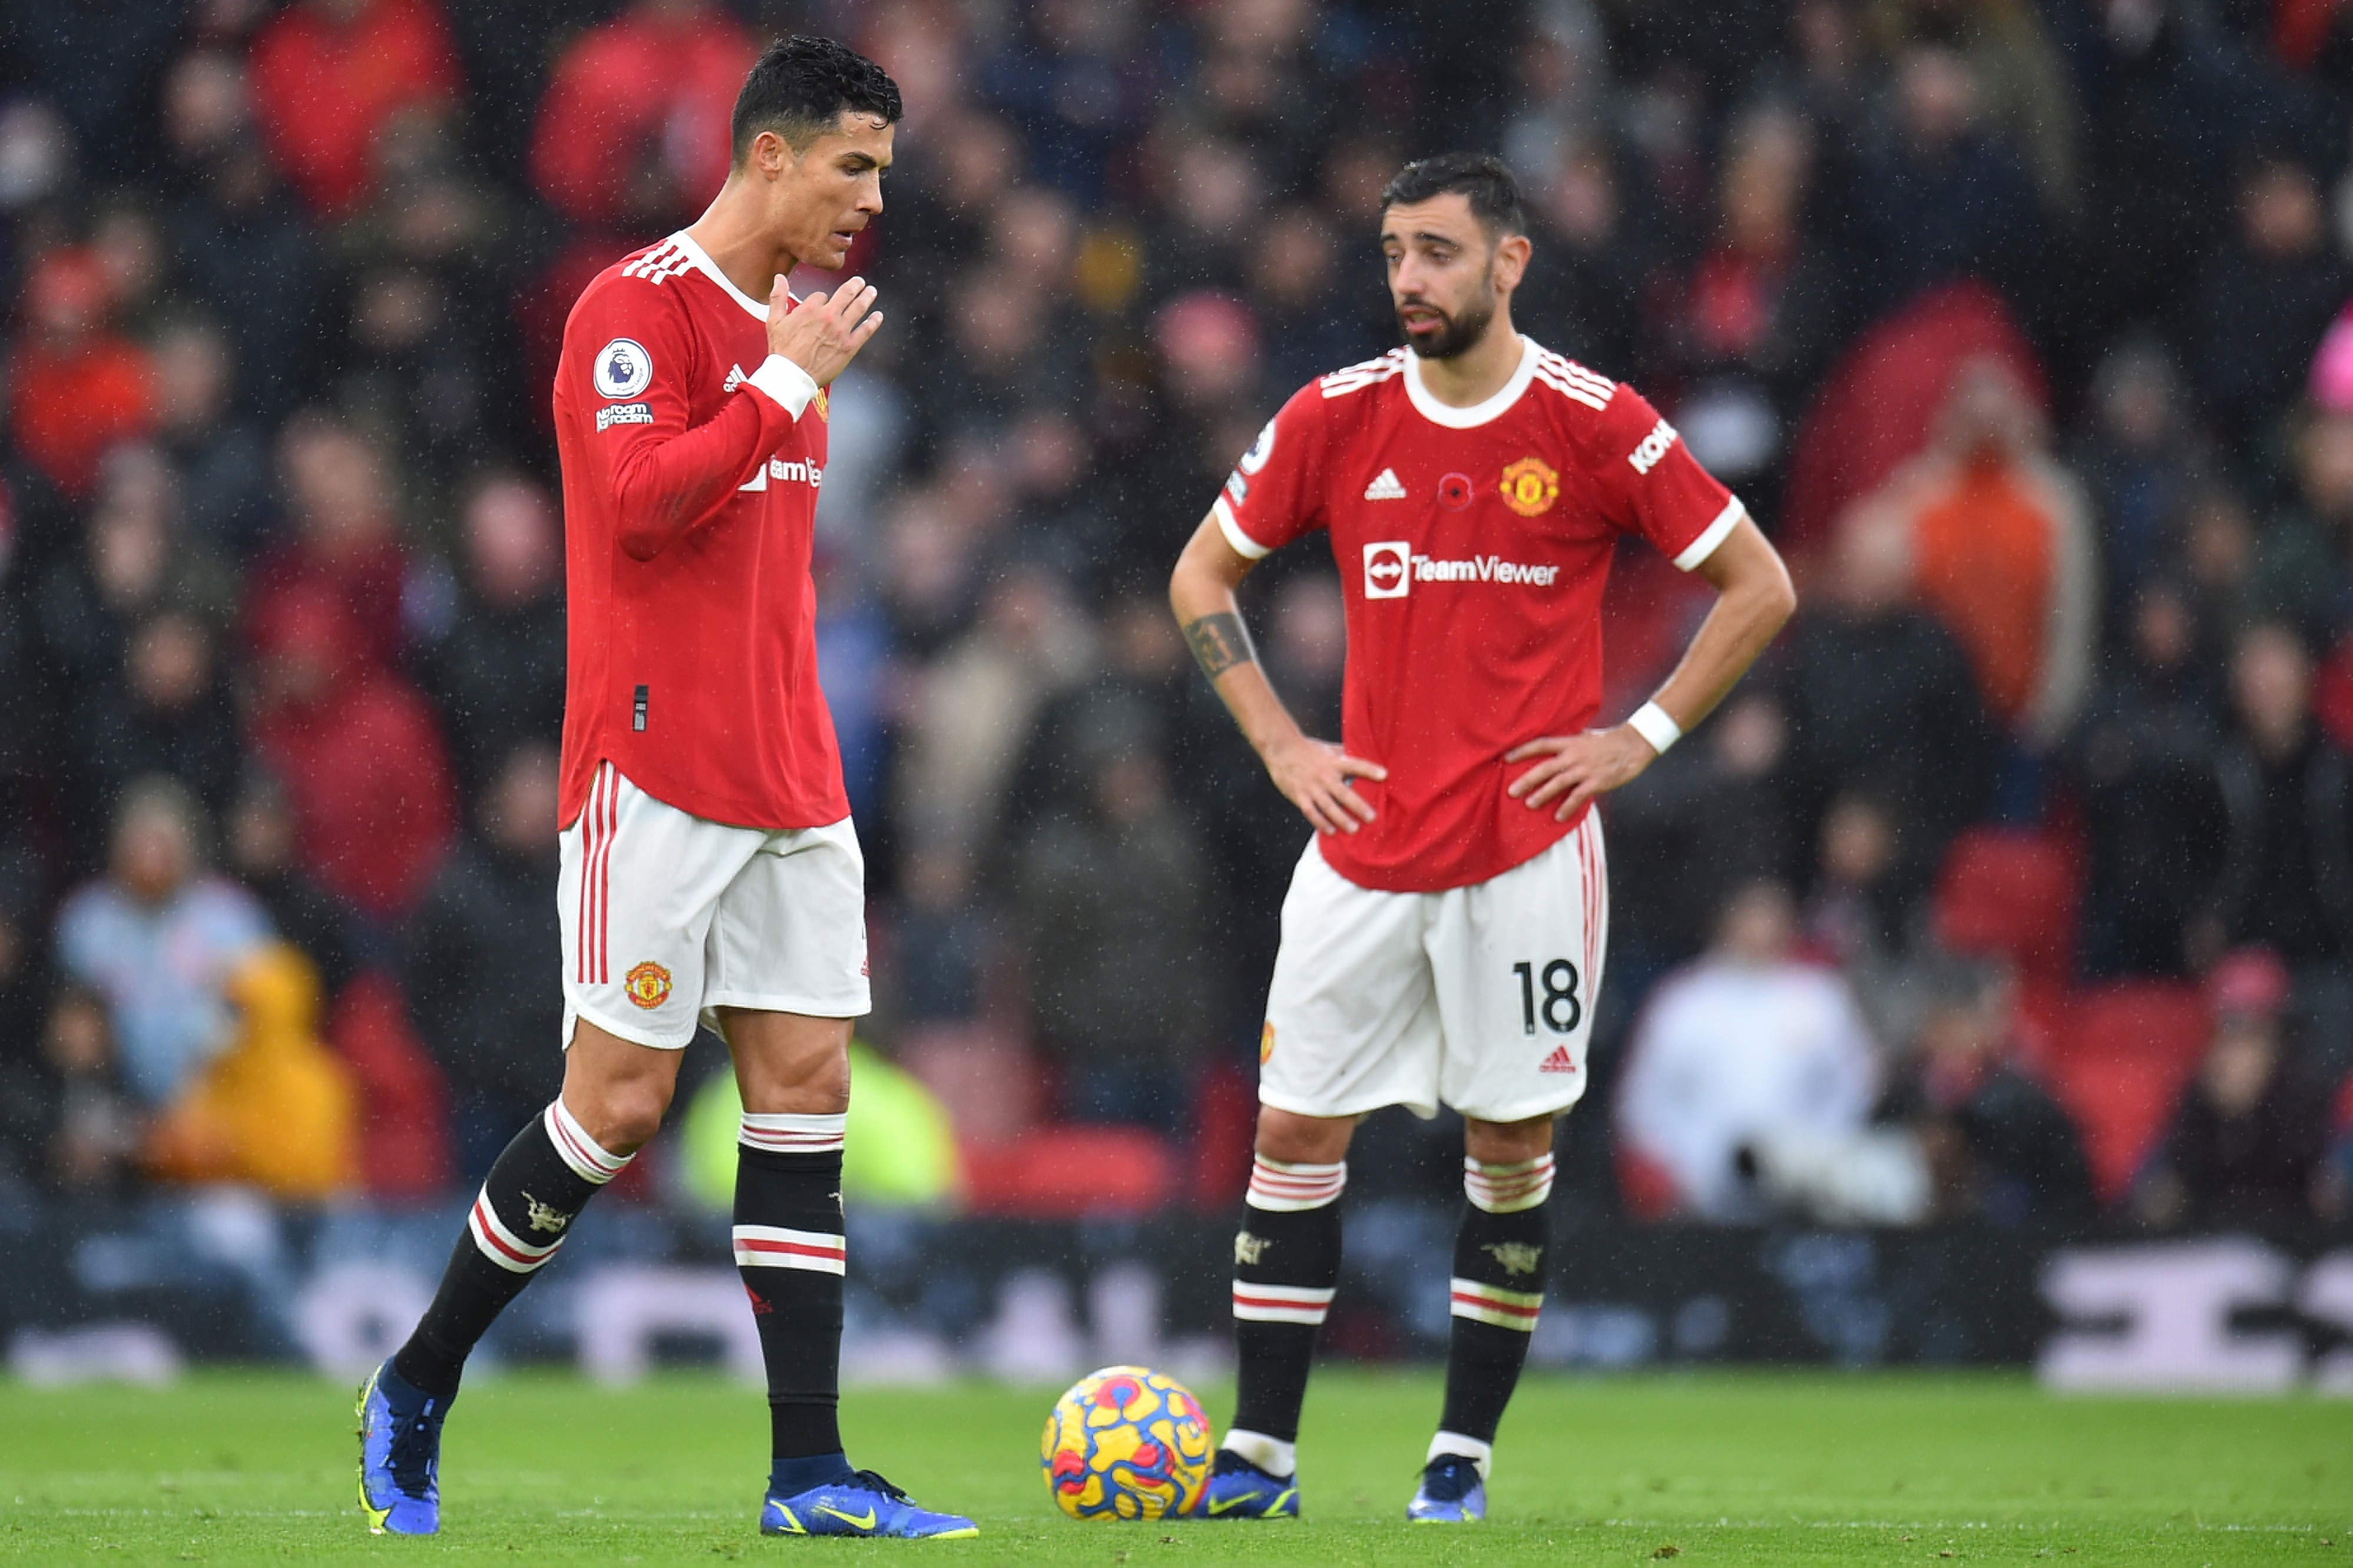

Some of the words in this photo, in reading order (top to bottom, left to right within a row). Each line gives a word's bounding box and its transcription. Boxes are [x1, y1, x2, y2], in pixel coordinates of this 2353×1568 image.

[610, 403, 647, 415] room
[1411, 555, 1560, 586] TeamViewer
[1512, 958, 1581, 1035] 18
